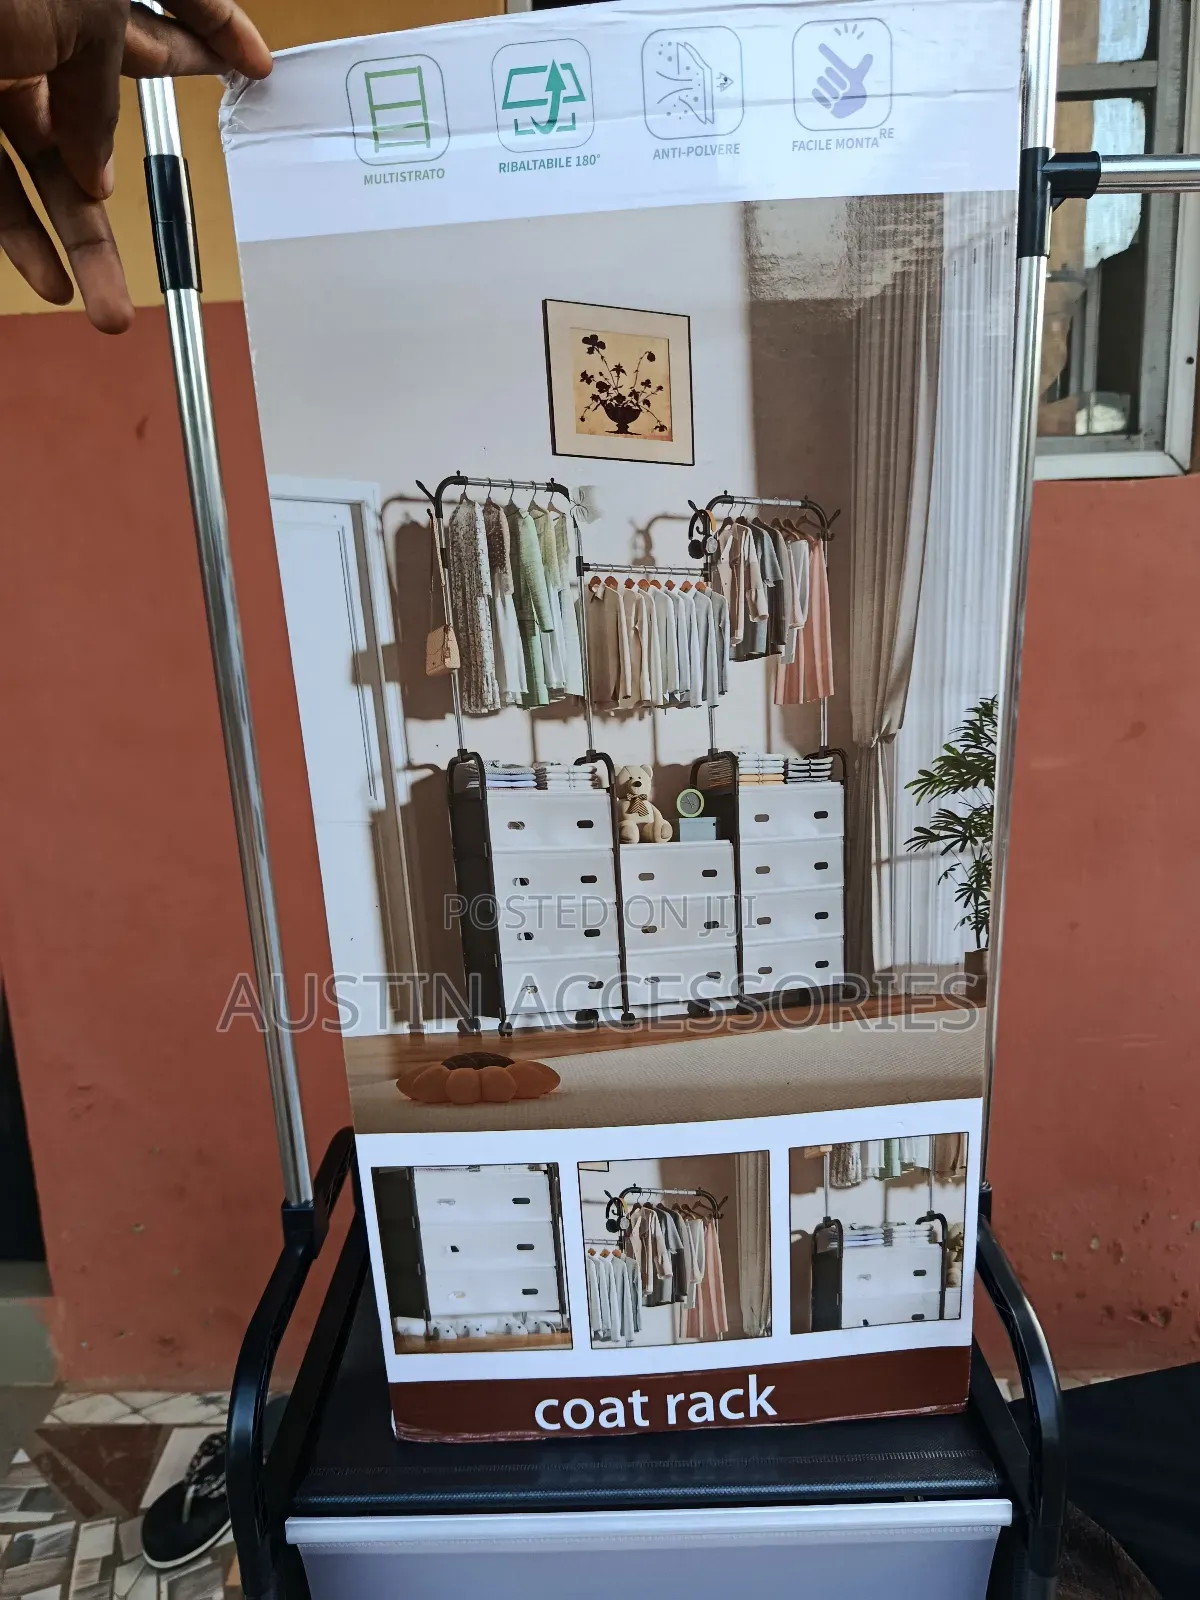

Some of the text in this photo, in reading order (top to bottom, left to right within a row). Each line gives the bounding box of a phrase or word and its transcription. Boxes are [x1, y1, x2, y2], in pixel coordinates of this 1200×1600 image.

[791, 127, 895, 153] FACILE MONTARE
[652, 142, 741, 161] ANTI-POLVERE
[498, 153, 601, 174] RIBALTABILE 180°
[363, 168, 446, 186] MULTISTRATO
[534, 1374, 778, 1431] coat rack
